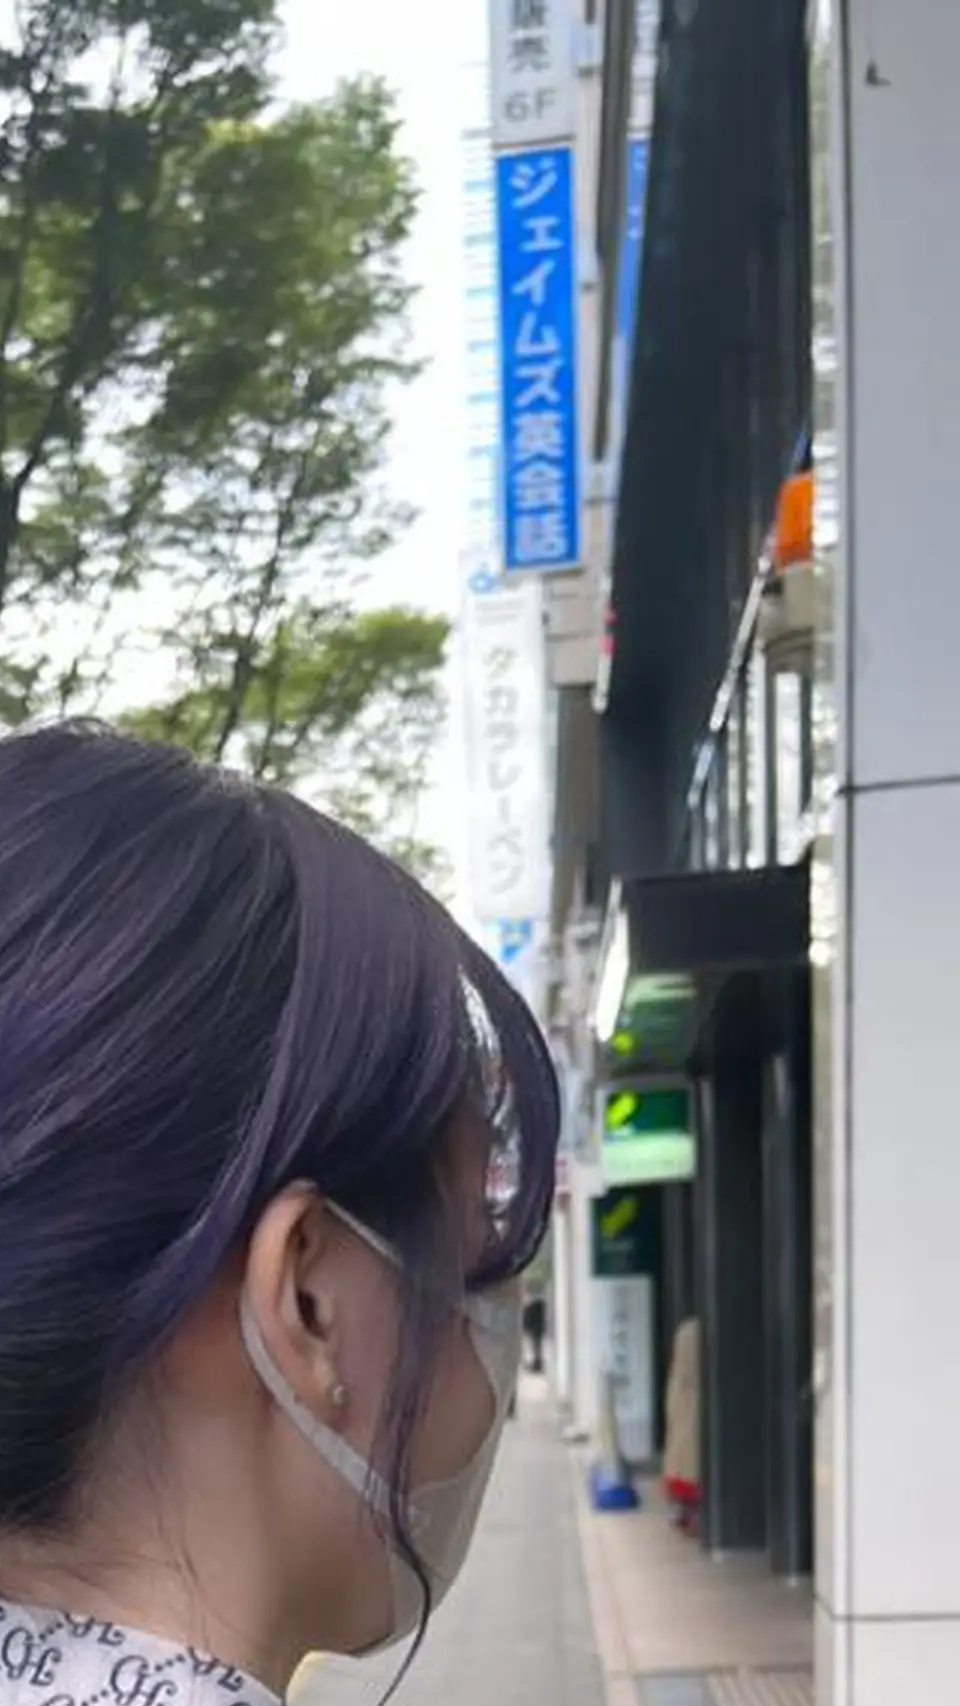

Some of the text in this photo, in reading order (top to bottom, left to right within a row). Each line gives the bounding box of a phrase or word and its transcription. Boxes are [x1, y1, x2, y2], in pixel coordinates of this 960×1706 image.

[504, 87, 558, 122] 6F
[508, 156, 567, 562] ジェイムズ英会話
